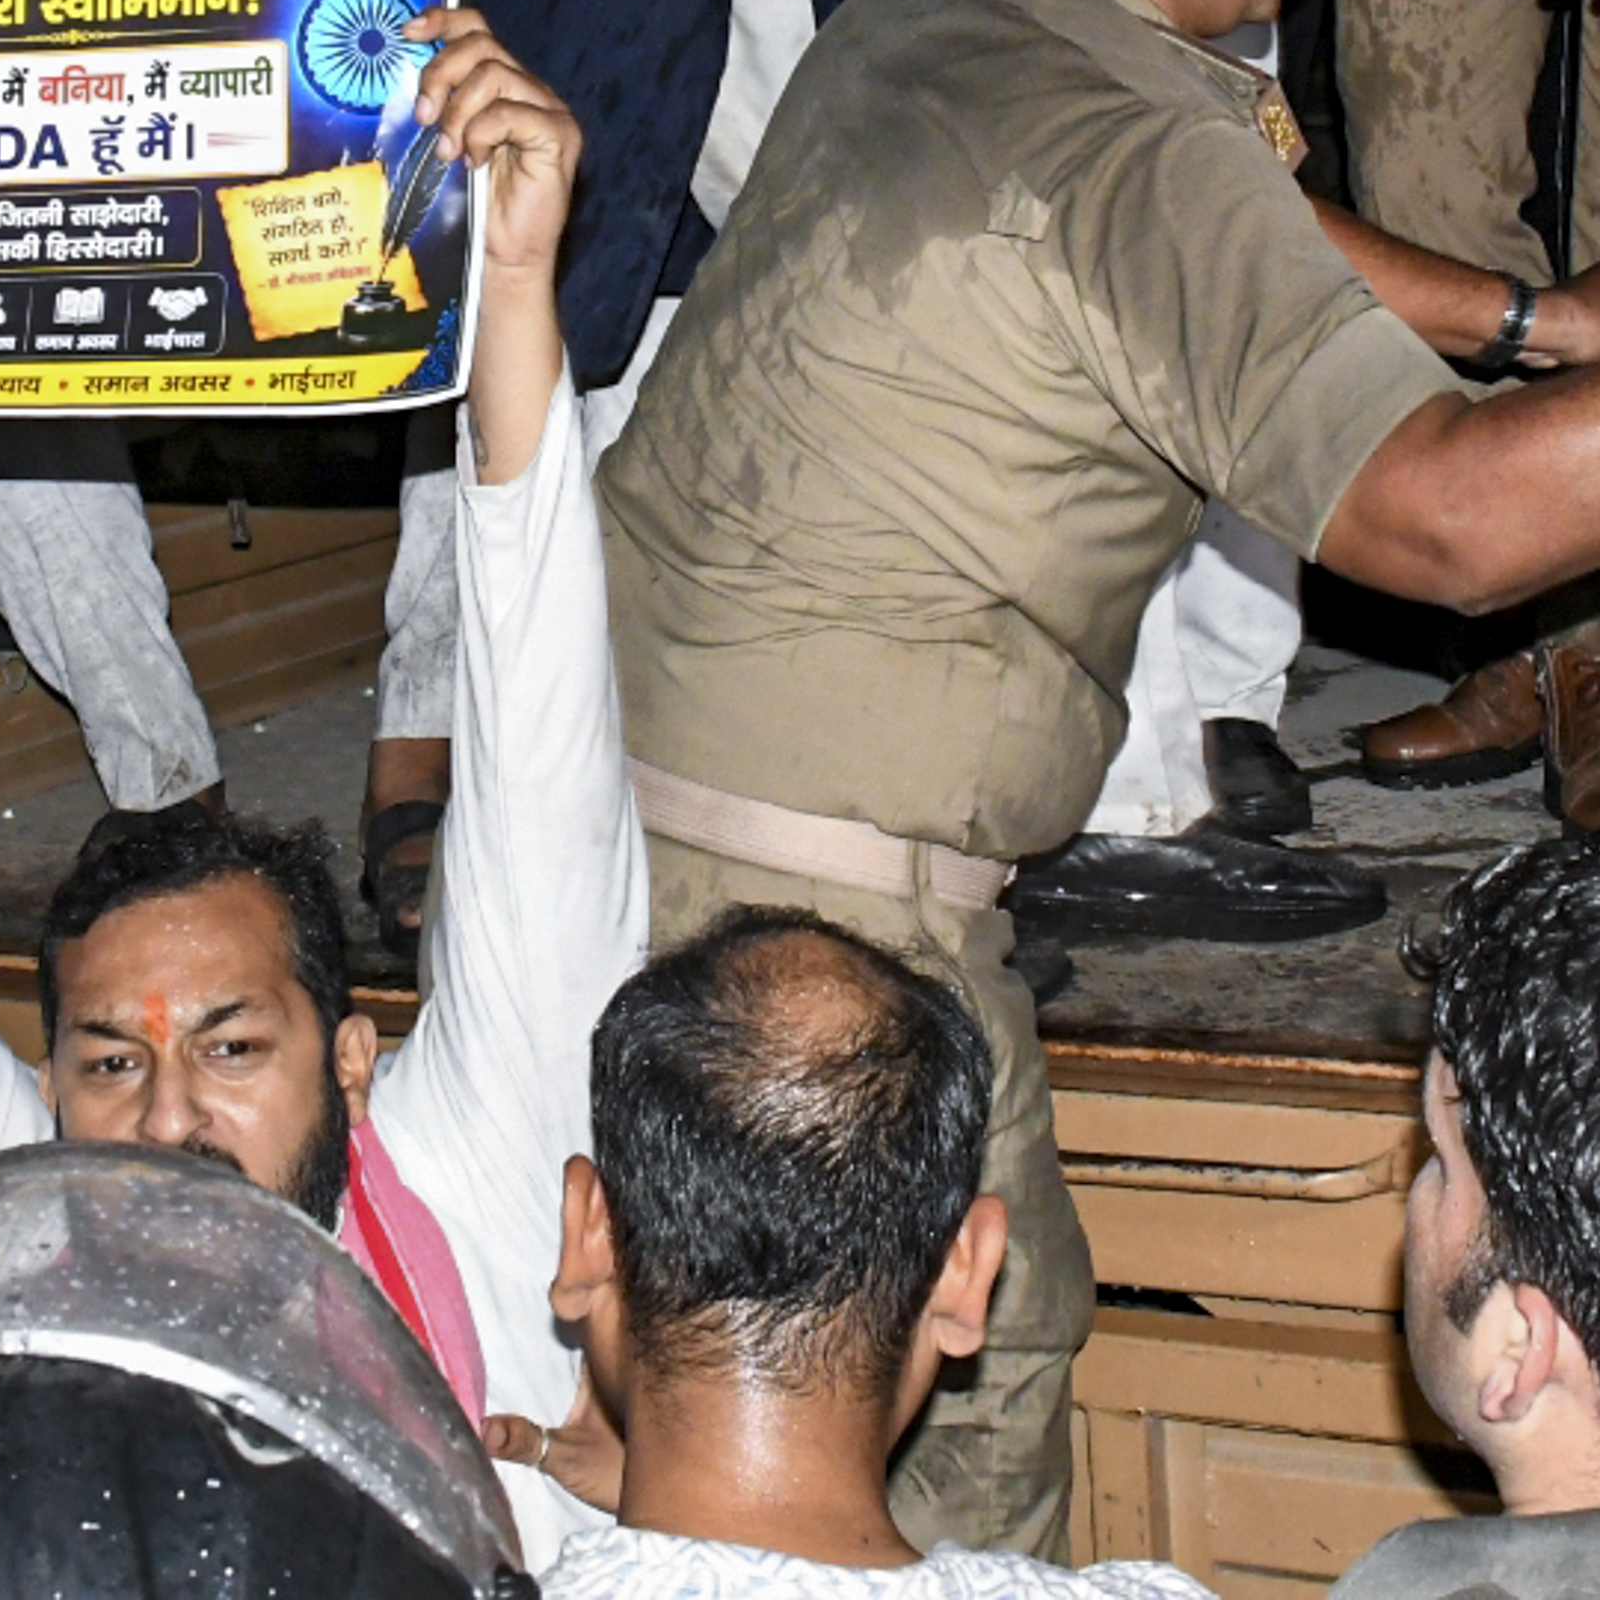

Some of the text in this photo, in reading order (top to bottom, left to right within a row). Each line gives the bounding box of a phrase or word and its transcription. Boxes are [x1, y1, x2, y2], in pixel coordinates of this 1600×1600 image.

[1, 67, 29, 107] मैं
[38, 65, 134, 106] बनिया,
[144, 60, 170, 100] मैं
[179, 56, 273, 98] व्यापारी
[83, 376, 150, 394] समान
[160, 374, 232, 393] अवसर
[268, 365, 357, 393] भाईचारा
